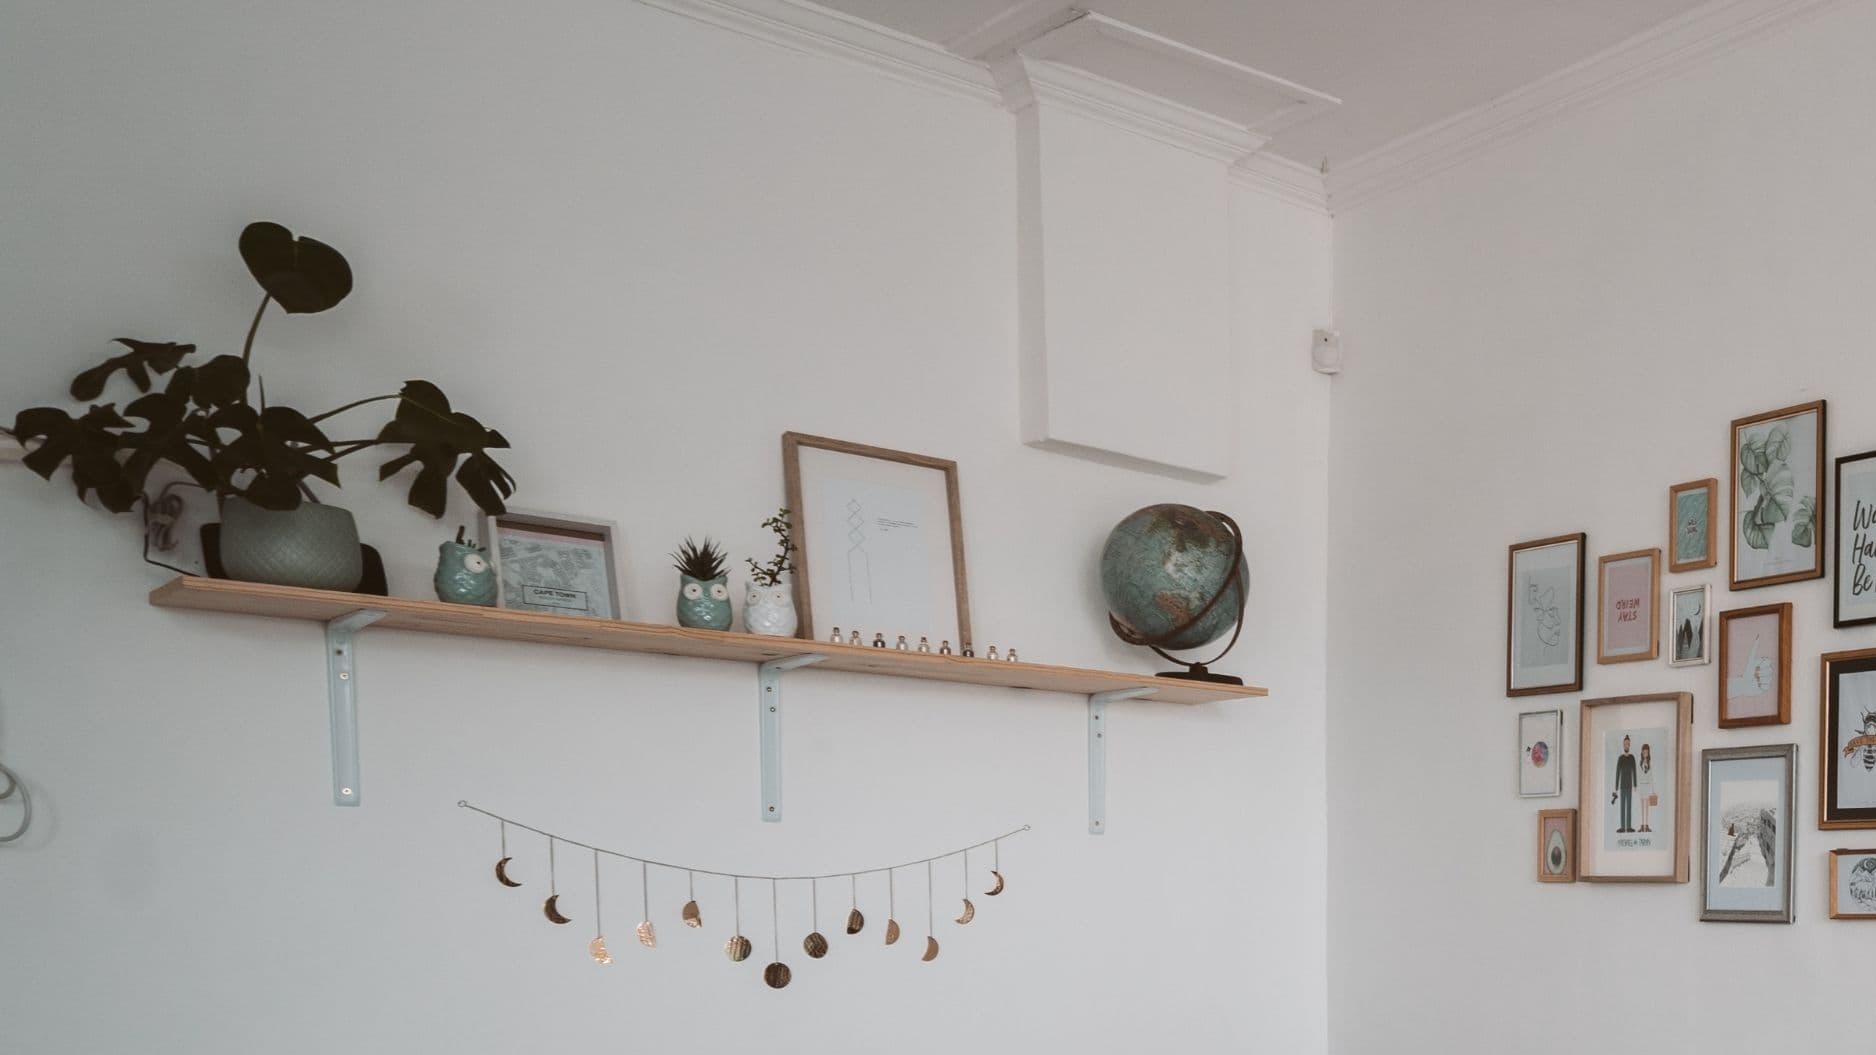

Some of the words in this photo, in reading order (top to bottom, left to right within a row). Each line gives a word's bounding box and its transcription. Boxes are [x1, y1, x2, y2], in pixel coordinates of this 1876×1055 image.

[1853, 563, 1873, 595] Be
[1616, 598, 1640, 610] WEIRD
[1617, 610, 1638, 623] STAY
